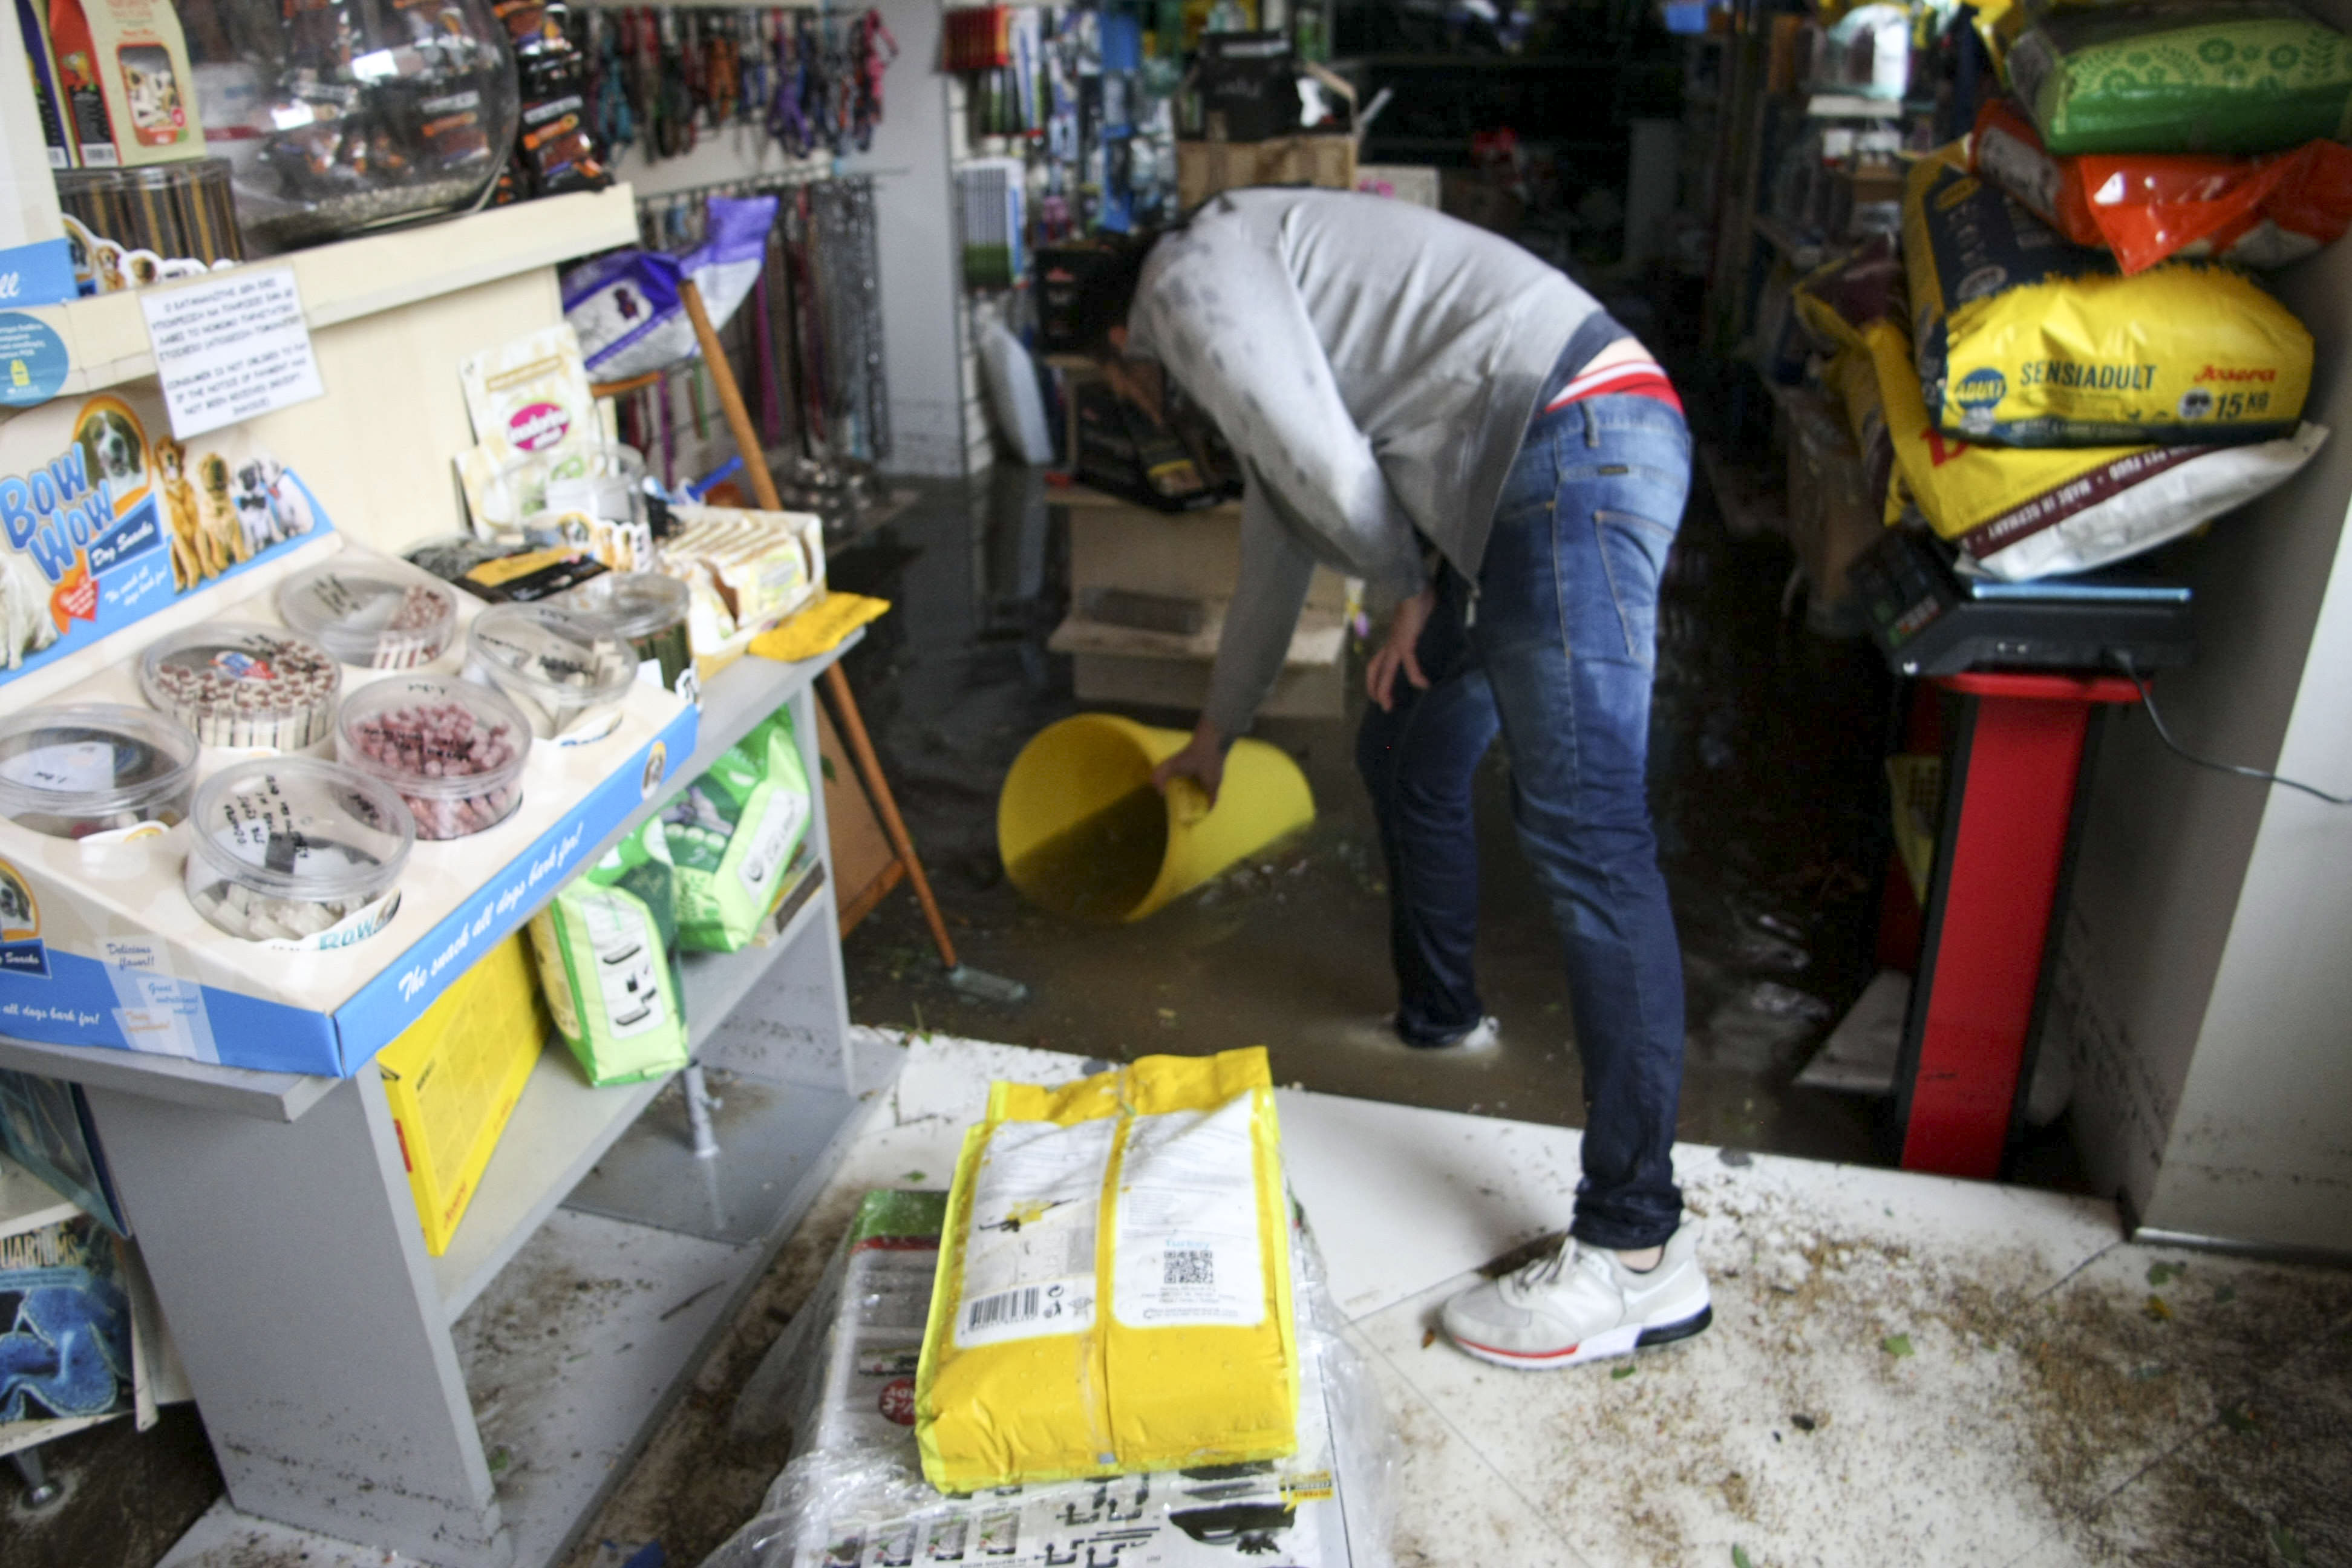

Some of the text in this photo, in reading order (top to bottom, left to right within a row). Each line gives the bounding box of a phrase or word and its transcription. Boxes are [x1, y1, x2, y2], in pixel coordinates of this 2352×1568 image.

[2020, 363, 2157, 391] SENSIADULT
[2216, 394, 2244, 420] 15
[0, 442, 87, 548] BOW
[29, 479, 114, 581] WOW
[398, 964, 428, 1002] The
[430, 922, 469, 977] snack
[3, 1004, 99, 1026] all dogs bark for!
